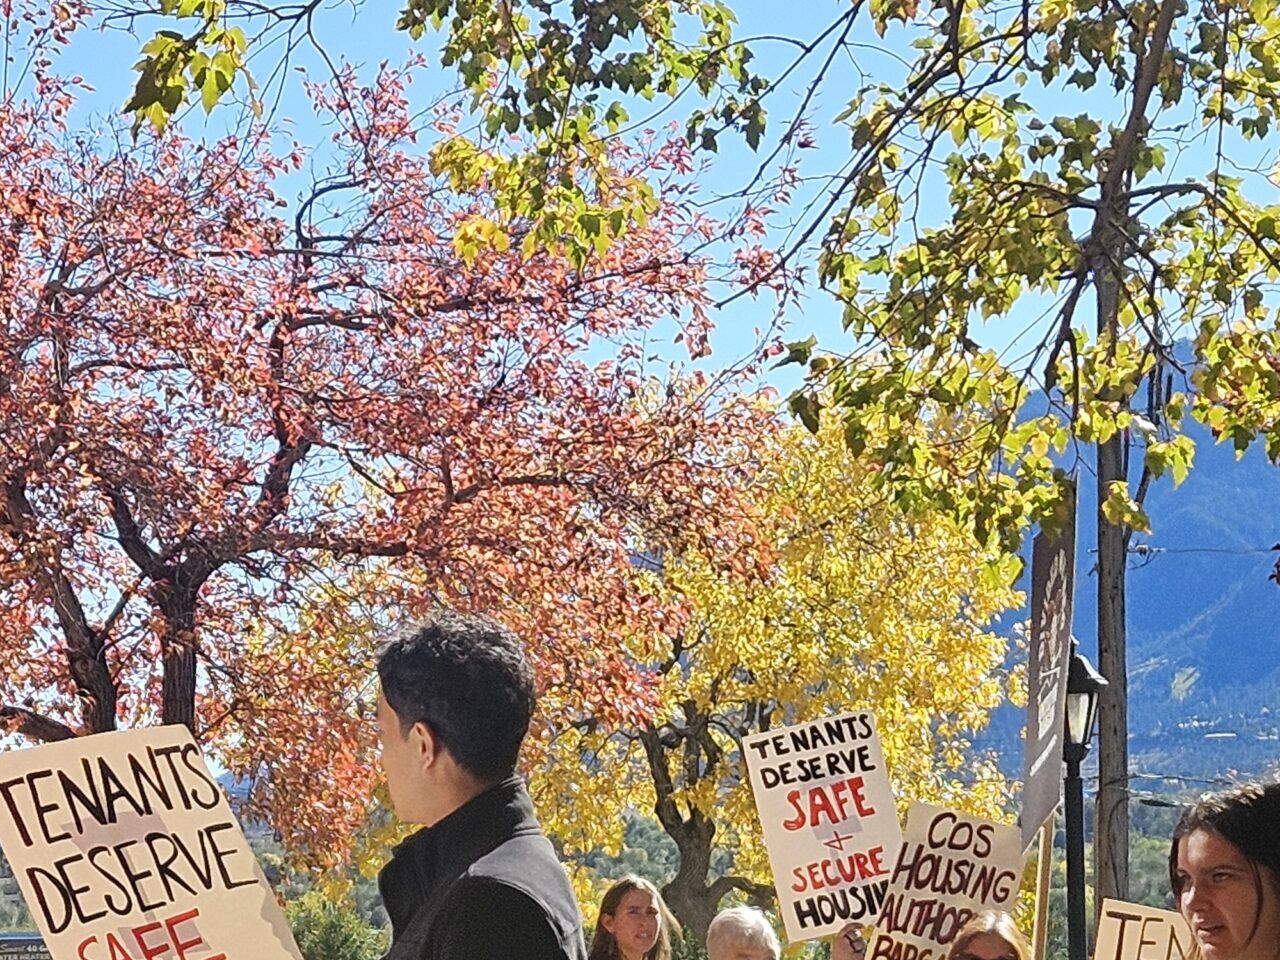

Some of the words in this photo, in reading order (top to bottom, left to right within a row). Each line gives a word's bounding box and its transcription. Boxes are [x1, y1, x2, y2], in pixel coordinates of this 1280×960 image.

[750, 714, 872, 760] TENANTS
[760, 745, 876, 789] DESERVE
[783, 776, 875, 831] SAFE
[928, 812, 994, 858] COS
[26, 822, 259, 934] DESERVE
[791, 846, 891, 893] SECURE
[891, 842, 1016, 904] HOUSING
[793, 879, 889, 929] HOUSIN
[876, 893, 976, 945] AUTHOR
